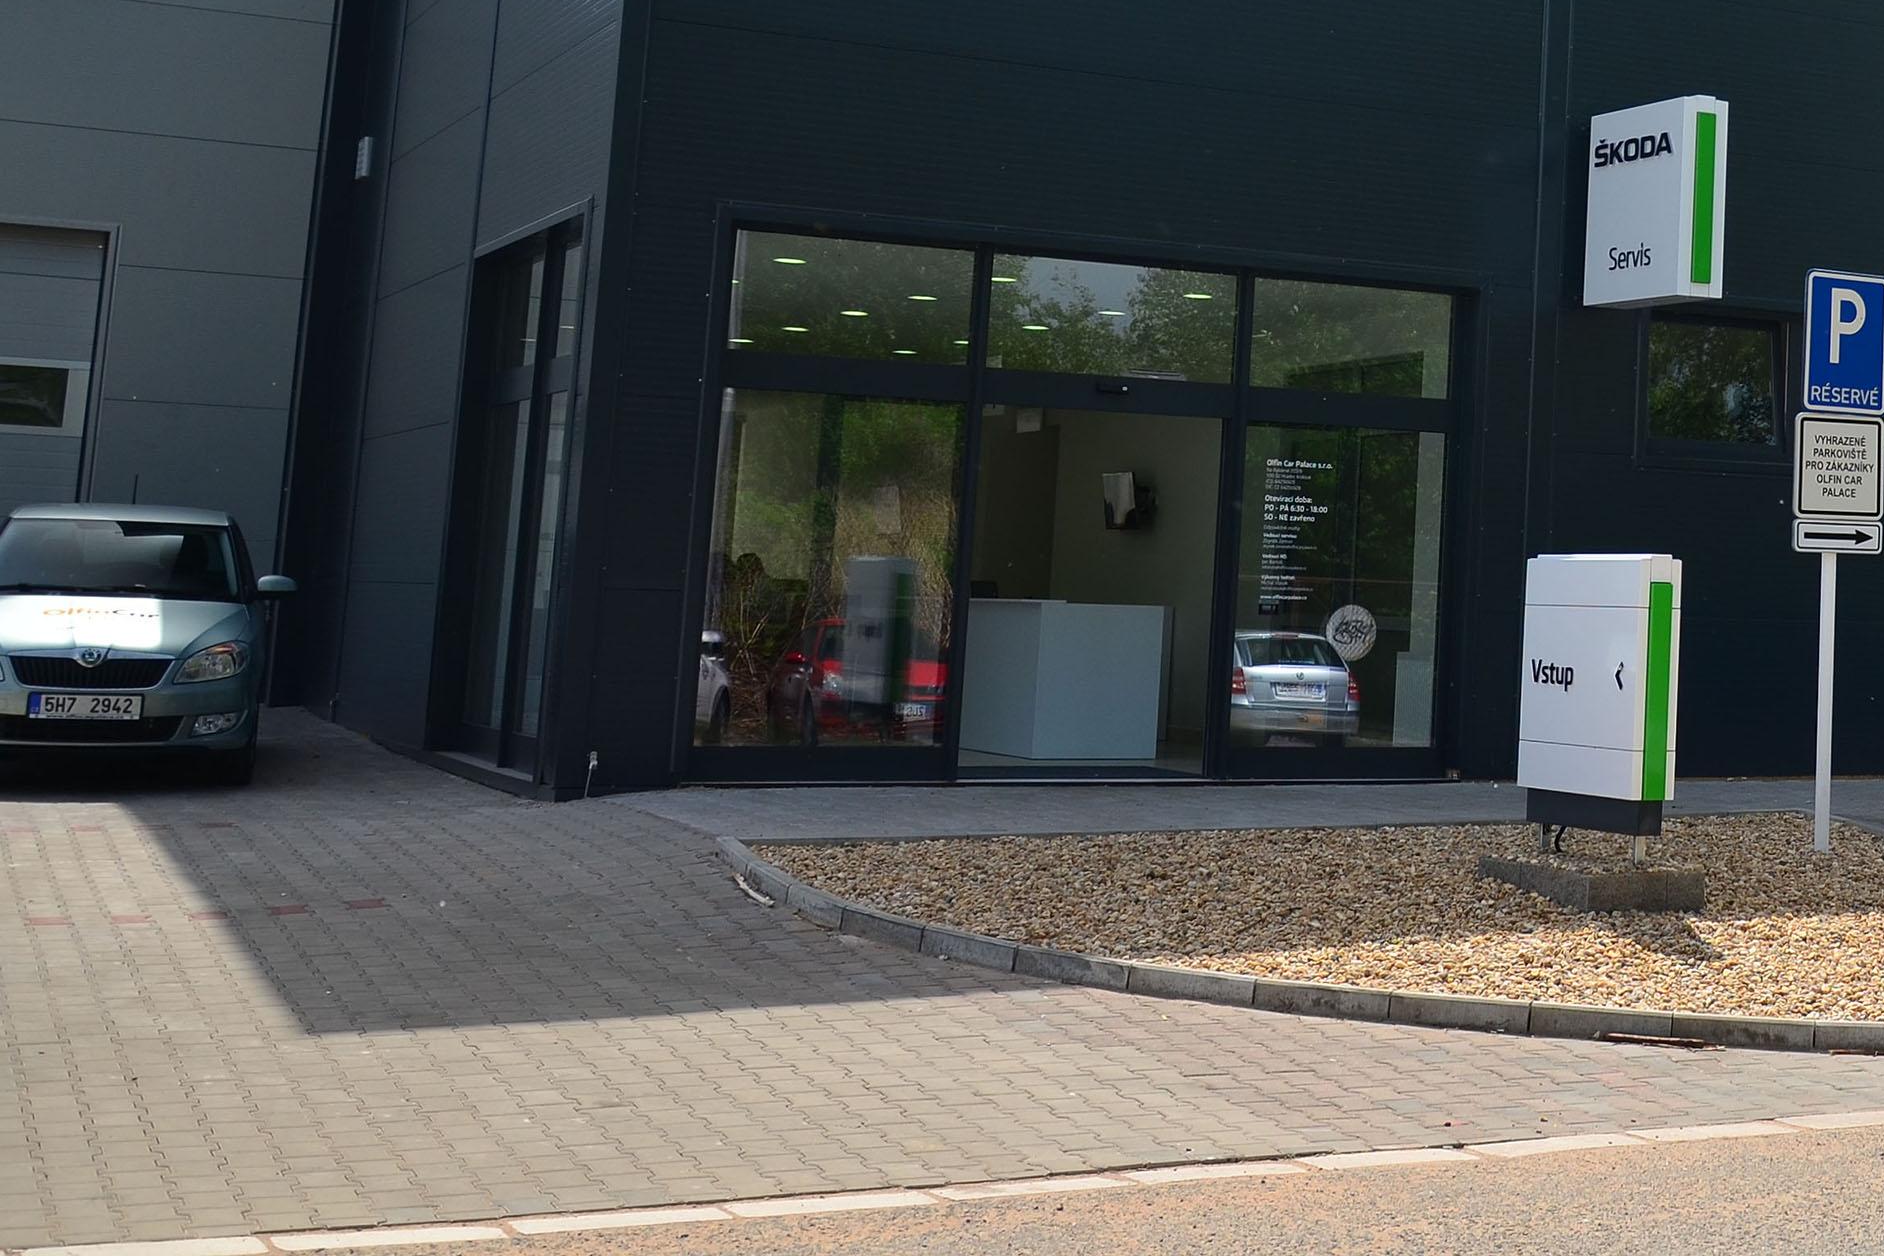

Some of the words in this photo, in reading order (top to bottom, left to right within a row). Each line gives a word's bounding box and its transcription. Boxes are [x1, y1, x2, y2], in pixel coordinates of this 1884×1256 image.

[1594, 132, 1672, 168] ŠKODA
[1608, 242, 1651, 271] Servis
[1829, 286, 1866, 364] P
[1811, 382, 1879, 407] RÉSERVÉ
[1815, 435, 1866, 447] VYHRAZENÉ
[1813, 448, 1867, 460] PARKOVIŠTĚ
[1266, 459, 1283, 467] Olfin
[1283, 459, 1295, 468] Car
[1295, 460, 1317, 468] Palace
[1805, 460, 1824, 471] PRO
[1826, 460, 1874, 473] ZÁKAZNÍKY
[1816, 474, 1842, 485] OLFIN
[1844, 475, 1863, 486] CAR
[1822, 487, 1857, 498] PALACE
[1531, 658, 1574, 692] Vstup
[44, 697, 78, 713] 5H7
[89, 697, 133, 714] 2942
